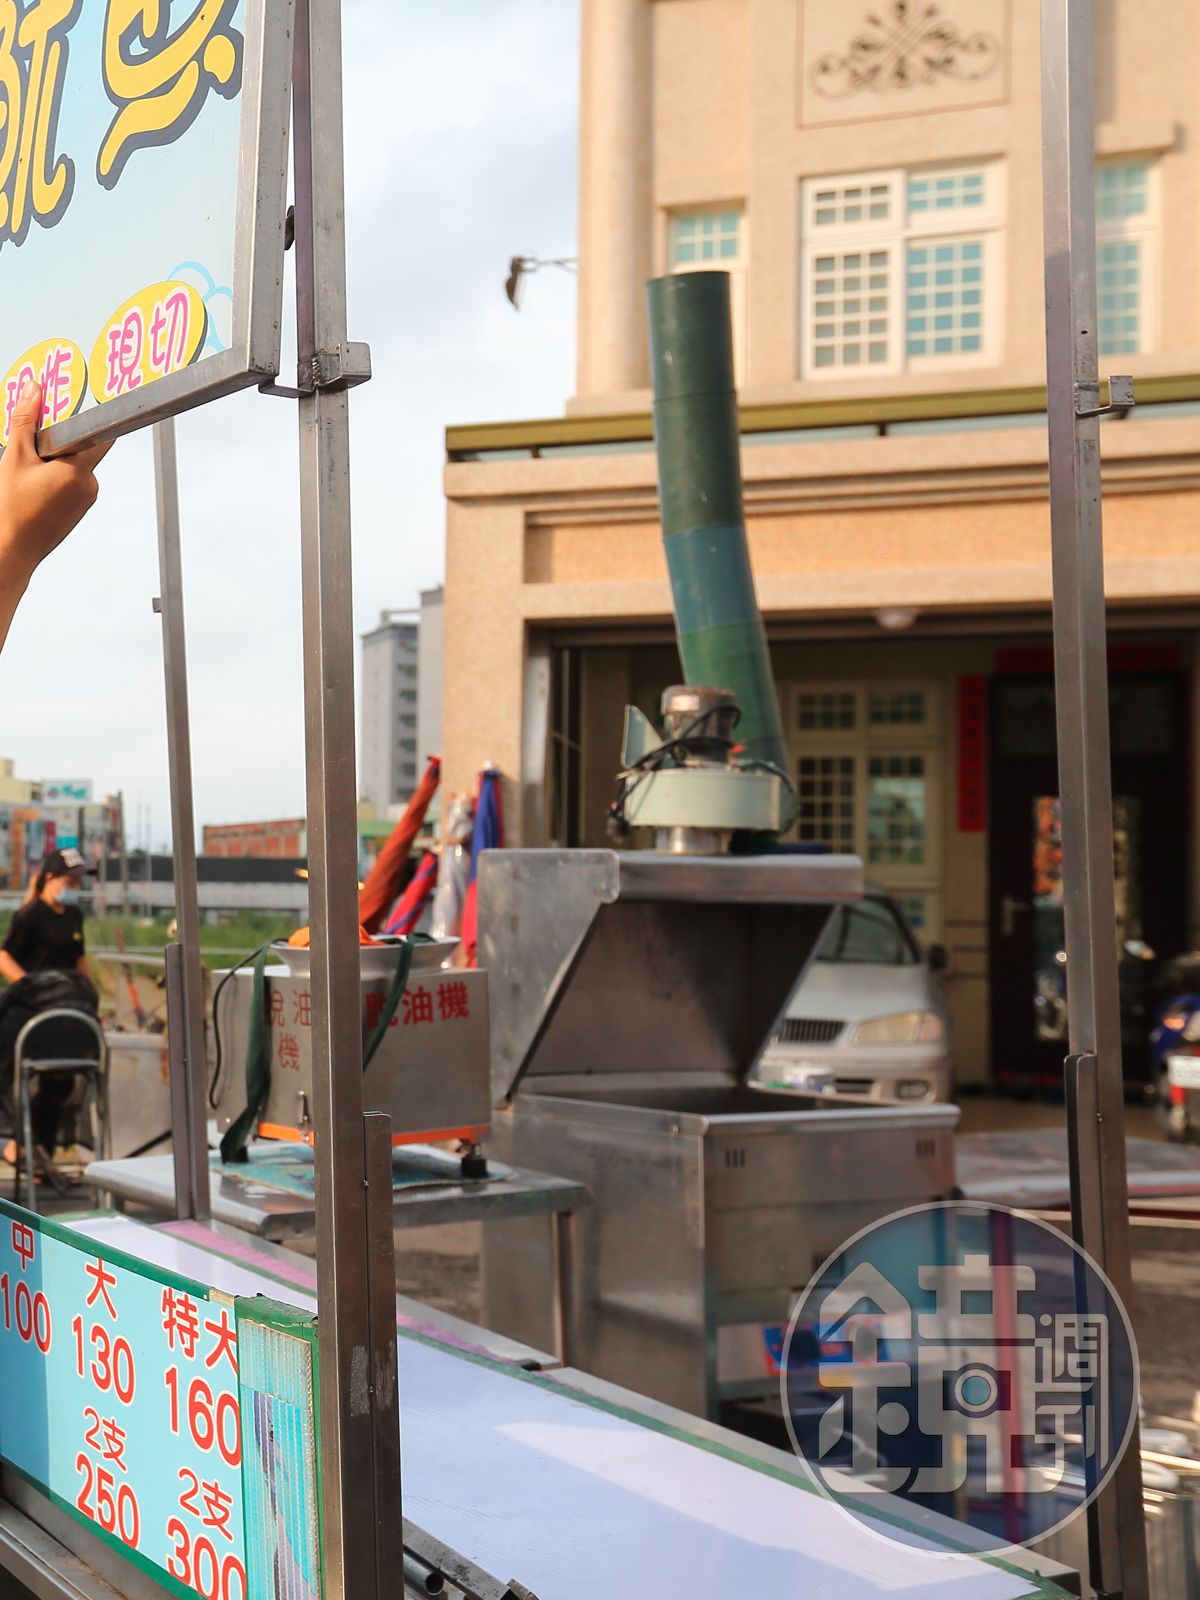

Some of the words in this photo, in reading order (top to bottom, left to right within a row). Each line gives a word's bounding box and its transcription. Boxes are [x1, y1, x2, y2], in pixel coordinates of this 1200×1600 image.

[107, 292, 189, 395] 現切
[13, 1221, 35, 1271] 中
[1, 1273, 52, 1354] 100
[85, 1257, 117, 1320] 大
[72, 1315, 136, 1405] 130
[161, 1287, 238, 1375] 特大
[84, 1408, 127, 1472] 2支
[165, 1366, 241, 1467] 160
[76, 1453, 140, 1550] 250
[179, 1468, 233, 1541] 2支
[167, 1517, 247, 1600] 300
